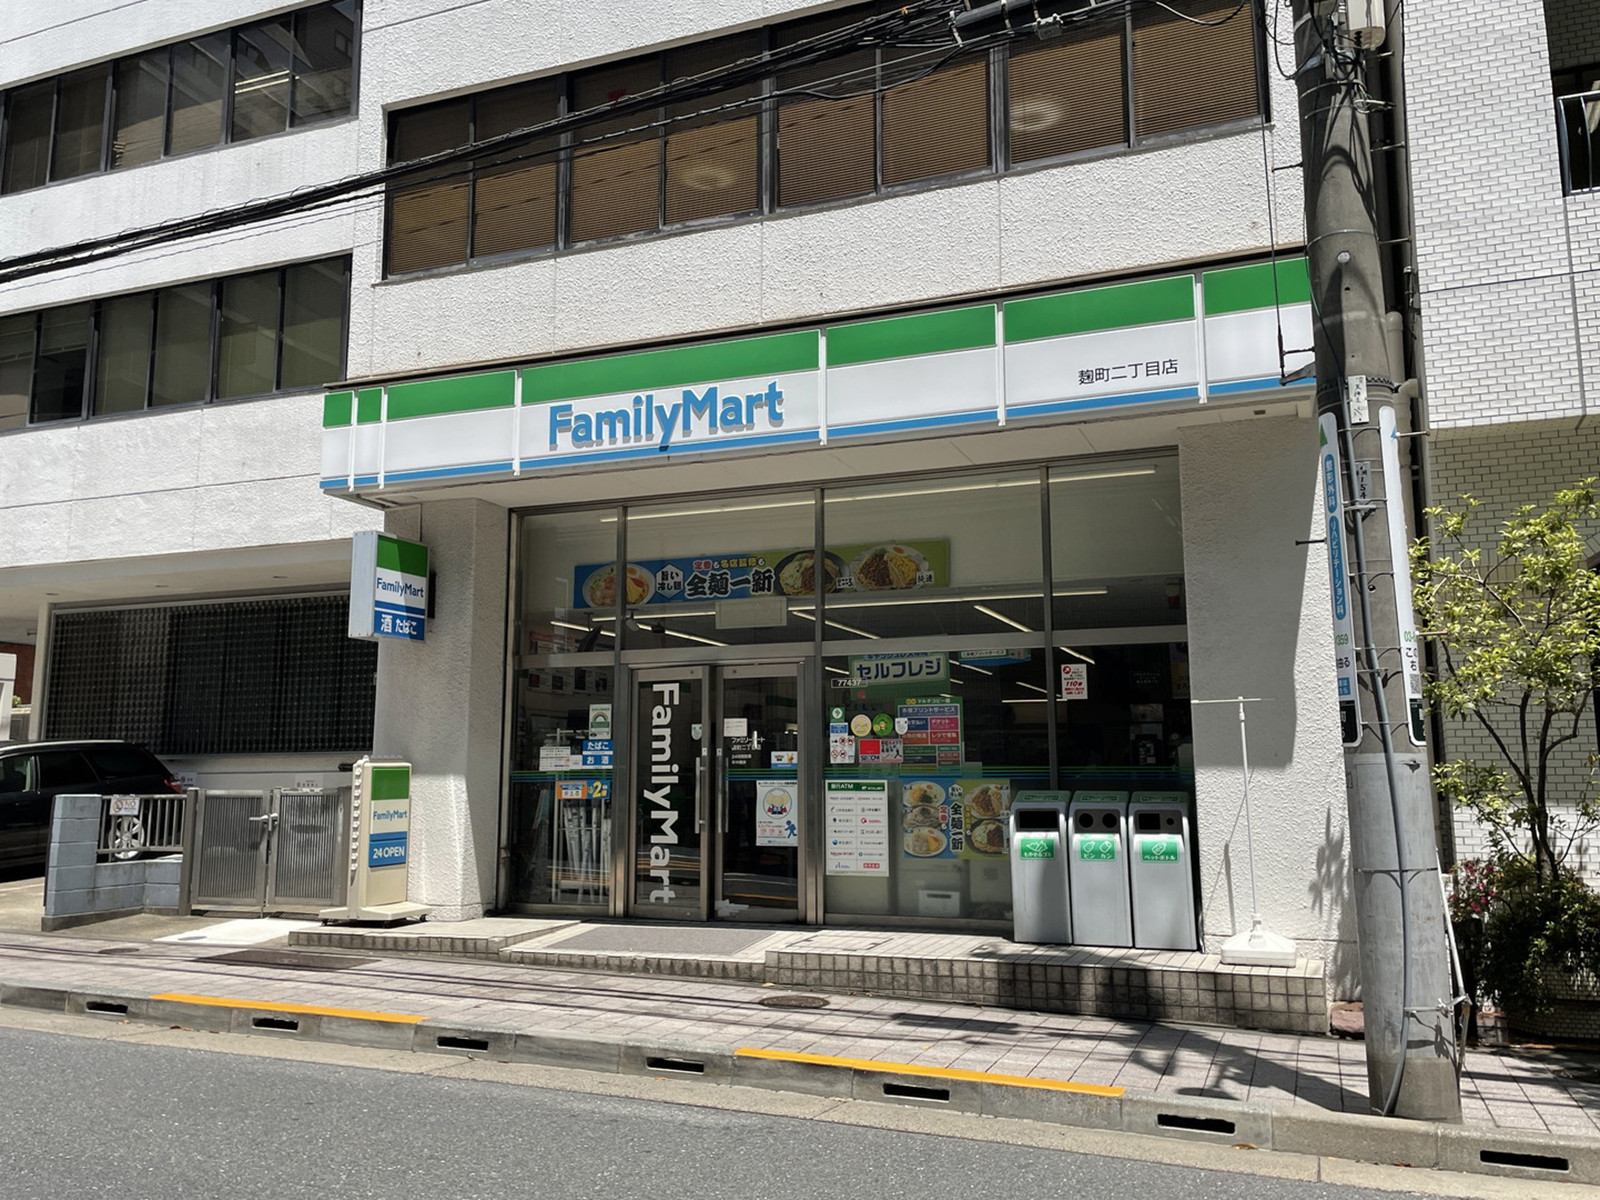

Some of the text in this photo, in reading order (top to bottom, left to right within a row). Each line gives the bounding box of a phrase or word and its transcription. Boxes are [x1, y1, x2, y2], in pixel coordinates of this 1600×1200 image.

[1078, 359, 1178, 385] 麹町二丁目店
[549, 380, 785, 451] FamilyMart
[376, 577, 424, 598] FamilyMart
[685, 569, 773, 597] 全麺一新
[380, 613, 417, 635] 酒 たばこ
[857, 658, 941, 680] セルフレジ
[837, 679, 862, 687] 77437
[587, 741, 609, 750] たばこ
[731, 736, 766, 744] ファミリーート
[643, 682, 680, 904] FamilyMart
[372, 809, 408, 822] FamilyMart
[950, 802, 963, 851] 全麺一新
